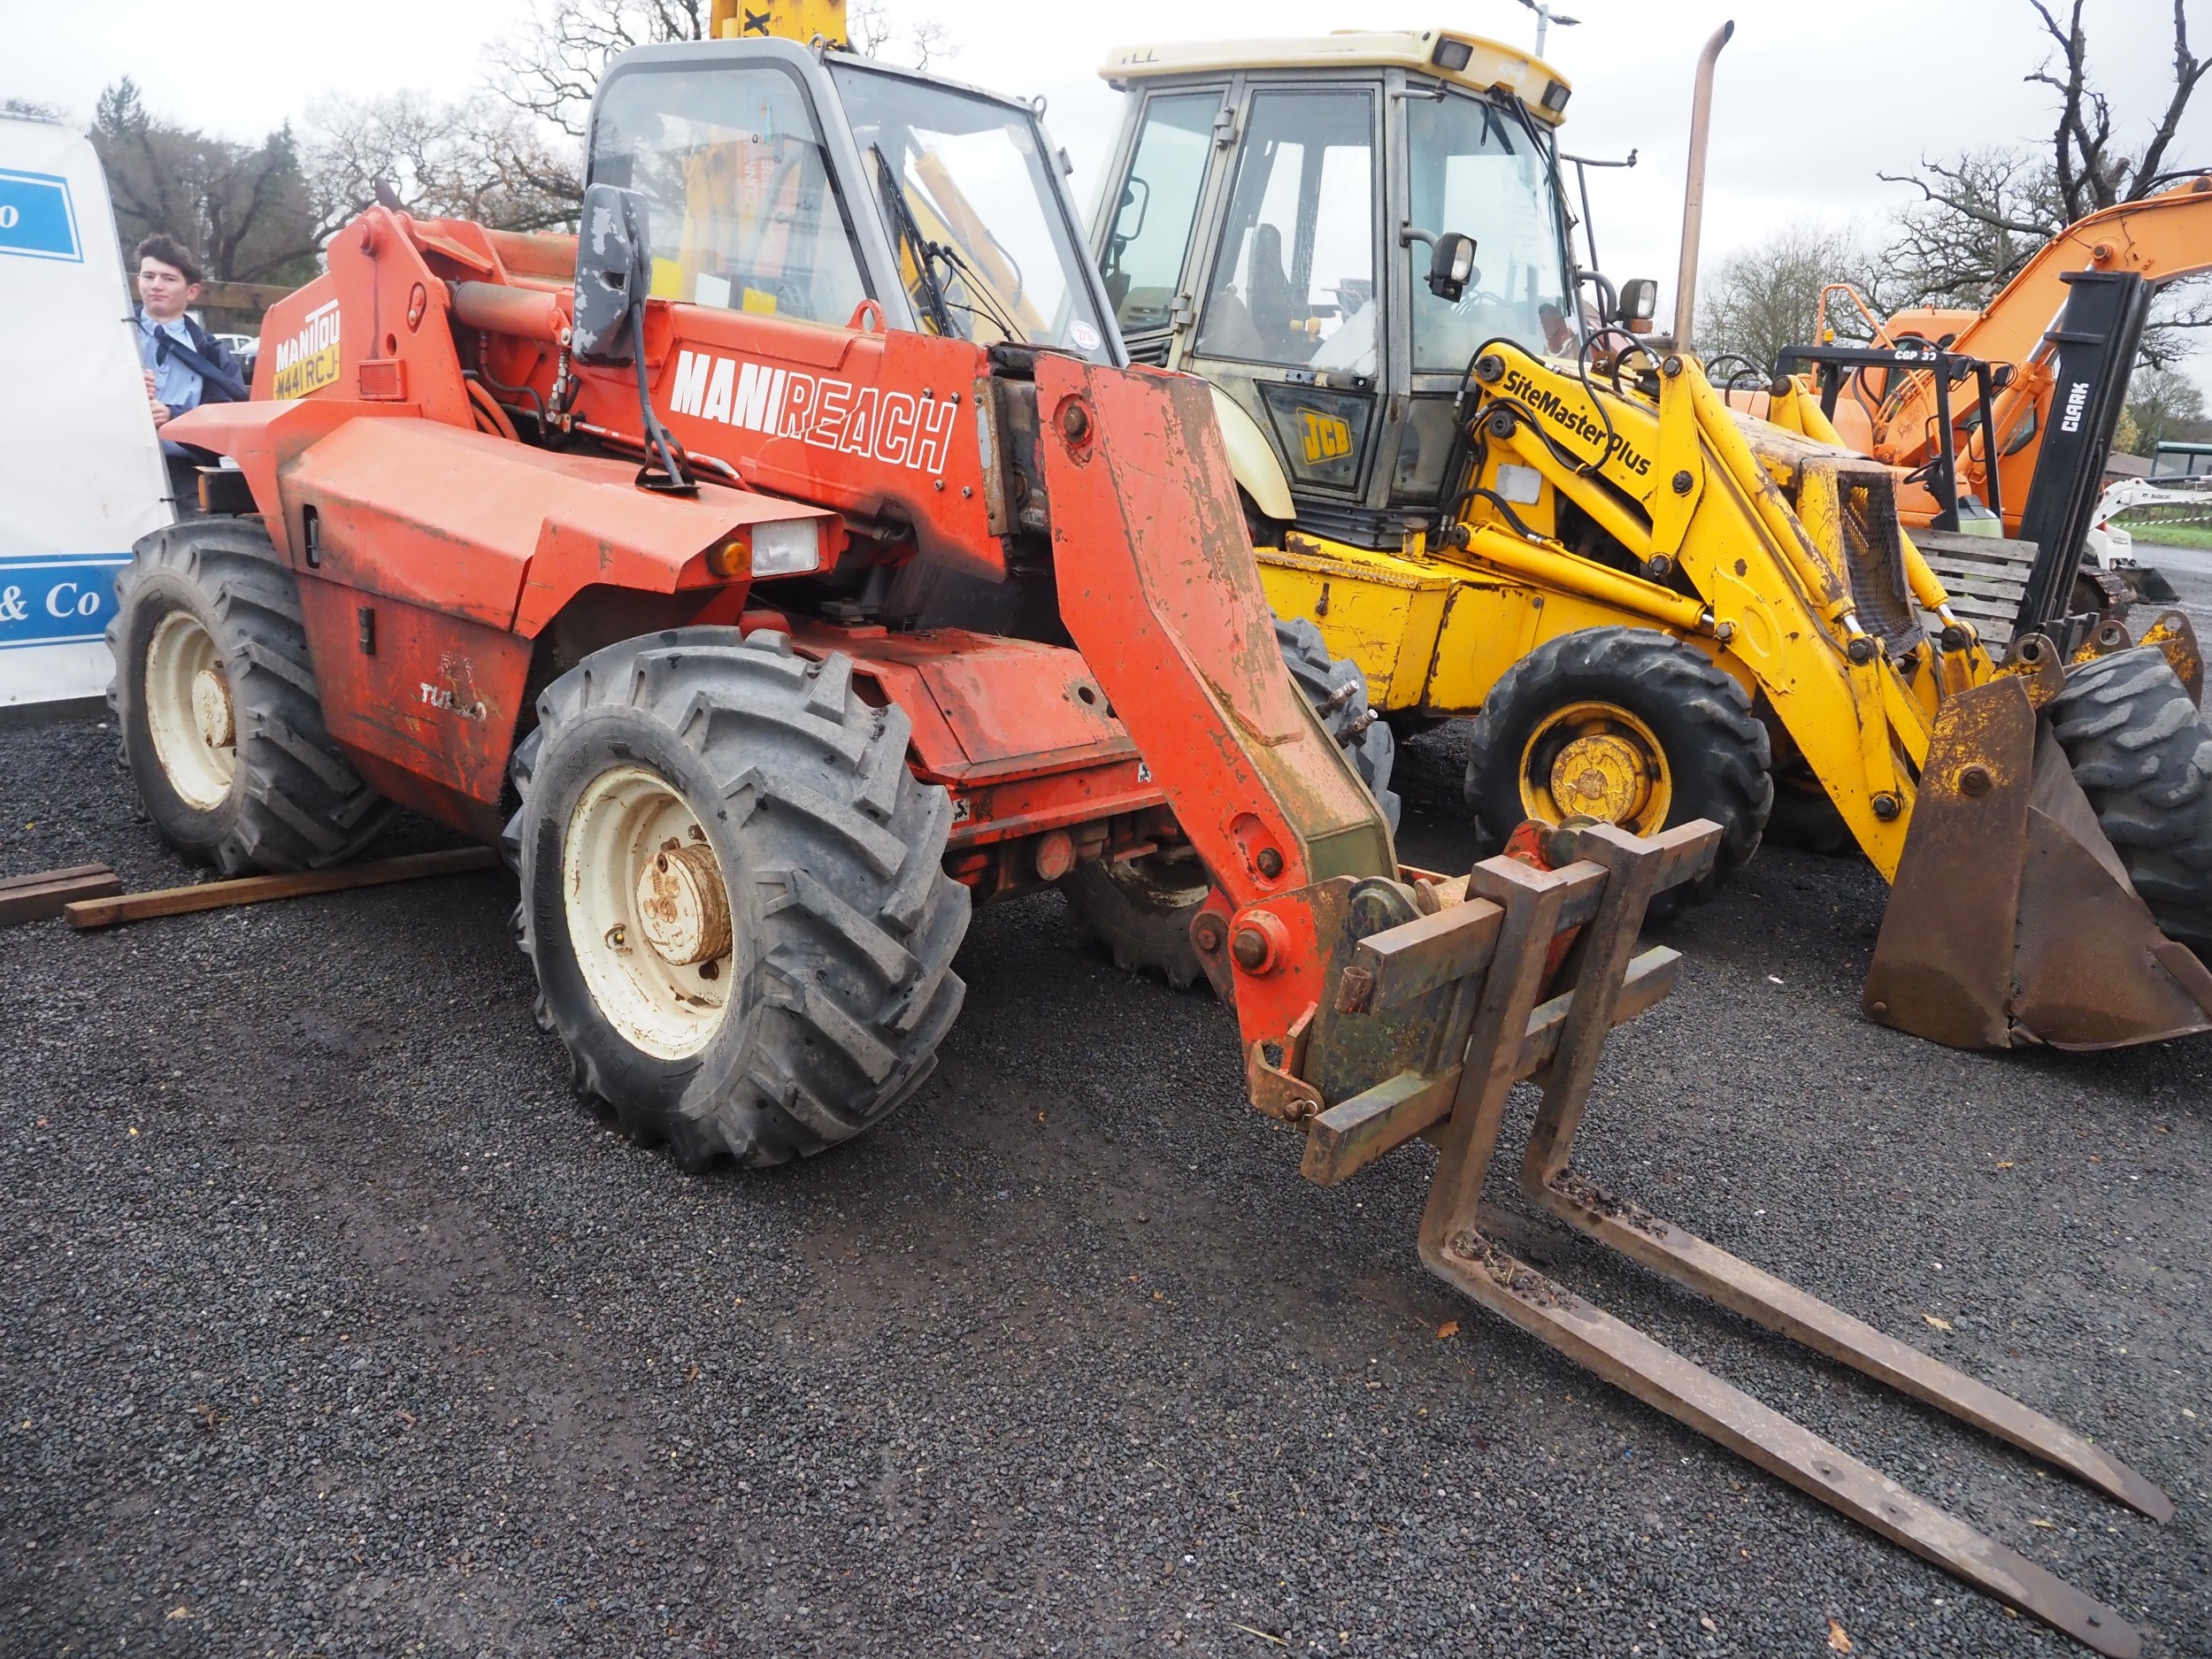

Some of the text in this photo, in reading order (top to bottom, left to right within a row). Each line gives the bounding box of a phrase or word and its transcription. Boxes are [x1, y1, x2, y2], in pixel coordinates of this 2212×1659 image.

[276, 298, 340, 373] MANITOU
[1894, 350, 1918, 360] CGP
[275, 349, 335, 400] M441 RCJ
[670, 349, 957, 474] MANIREACH
[2061, 382, 2089, 432] CLARK
[1304, 412, 1349, 461] JCB
[0, 582, 100, 621] & Co
